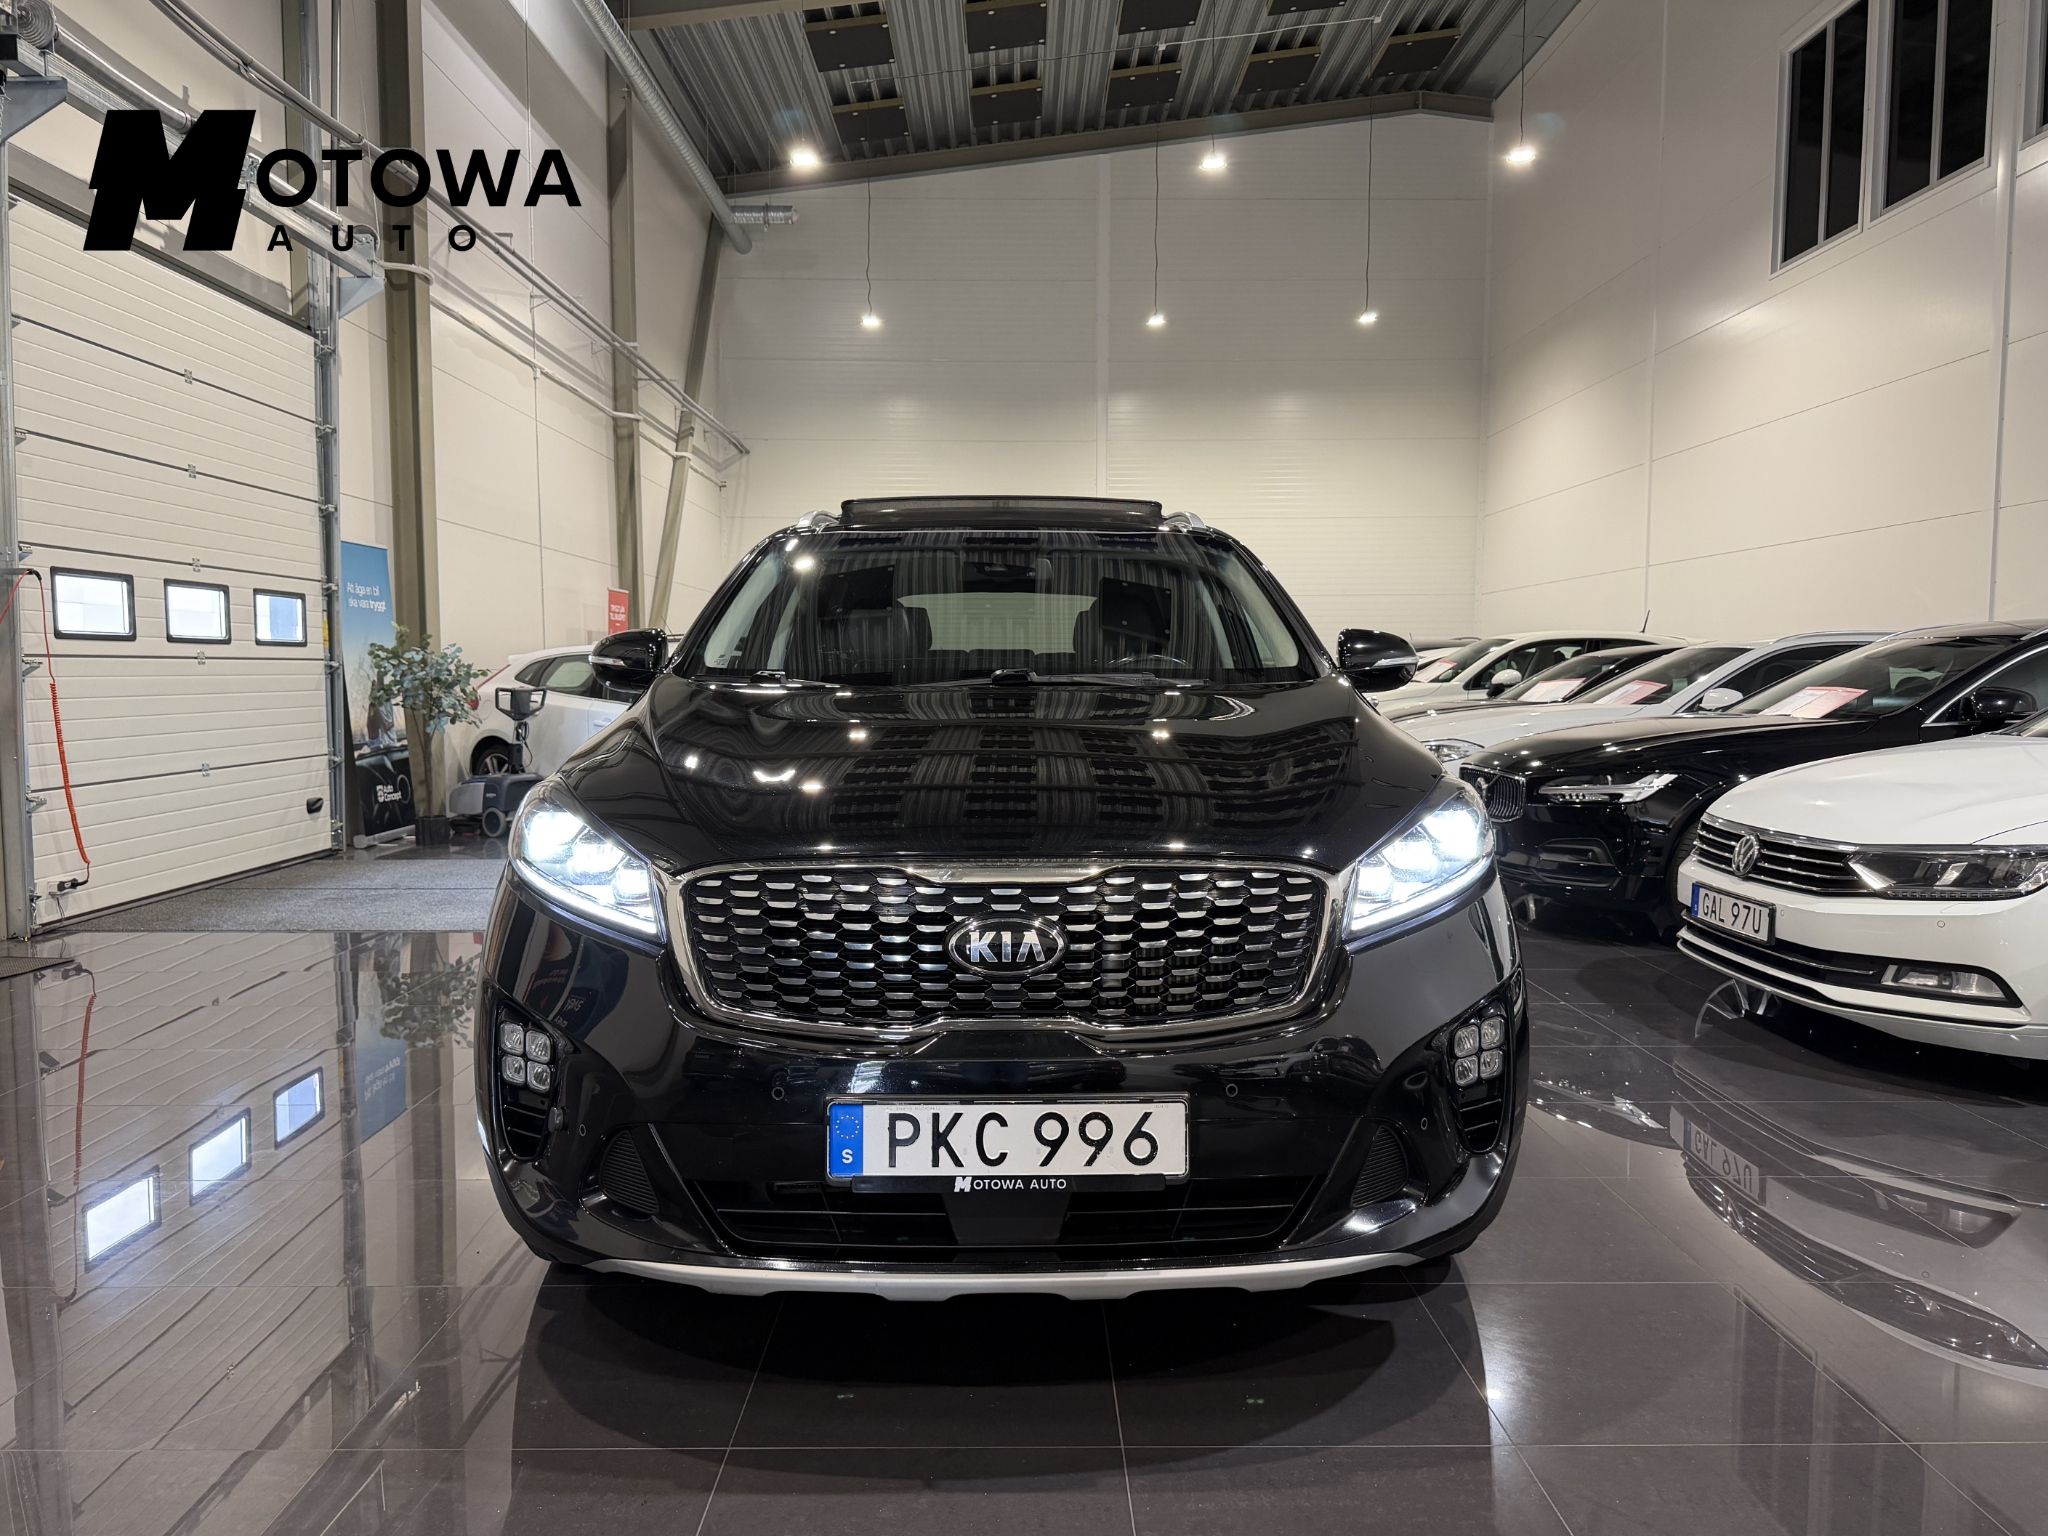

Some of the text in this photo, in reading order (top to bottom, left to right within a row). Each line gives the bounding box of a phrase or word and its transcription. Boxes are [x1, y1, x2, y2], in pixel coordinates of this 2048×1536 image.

[383, 784, 394, 793] Auto
[384, 790, 402, 802] Concept
[1702, 892, 1762, 934] GAL 97U
[968, 931, 1046, 963] KIA
[887, 1111, 1159, 1168] PKC 996
[841, 1148, 853, 1165] S
[954, 1176, 1068, 1193] MOTOWA AUTO
